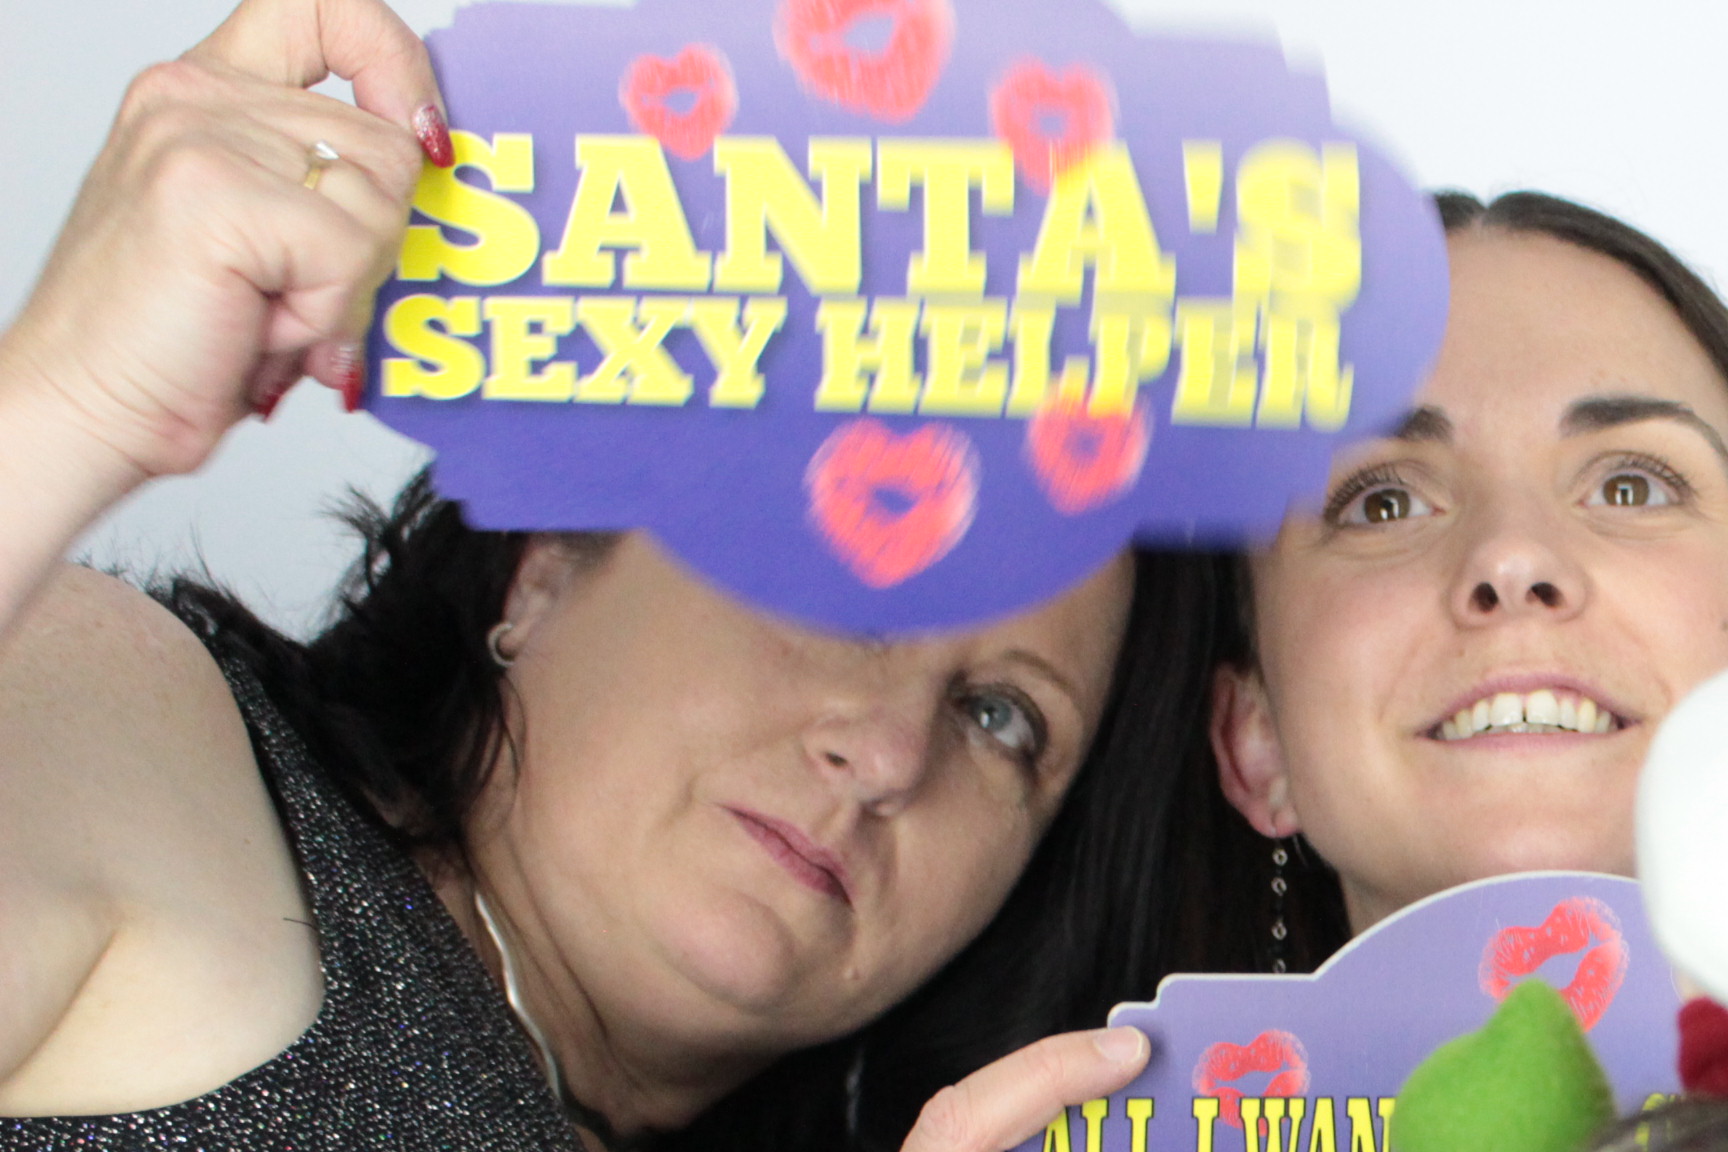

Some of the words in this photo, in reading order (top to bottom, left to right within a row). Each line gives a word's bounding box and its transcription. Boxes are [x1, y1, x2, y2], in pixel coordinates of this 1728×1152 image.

[397, 130, 1362, 308] SANTA'S
[381, 293, 789, 410] SEXY
[814, 296, 1354, 432] HELPER
